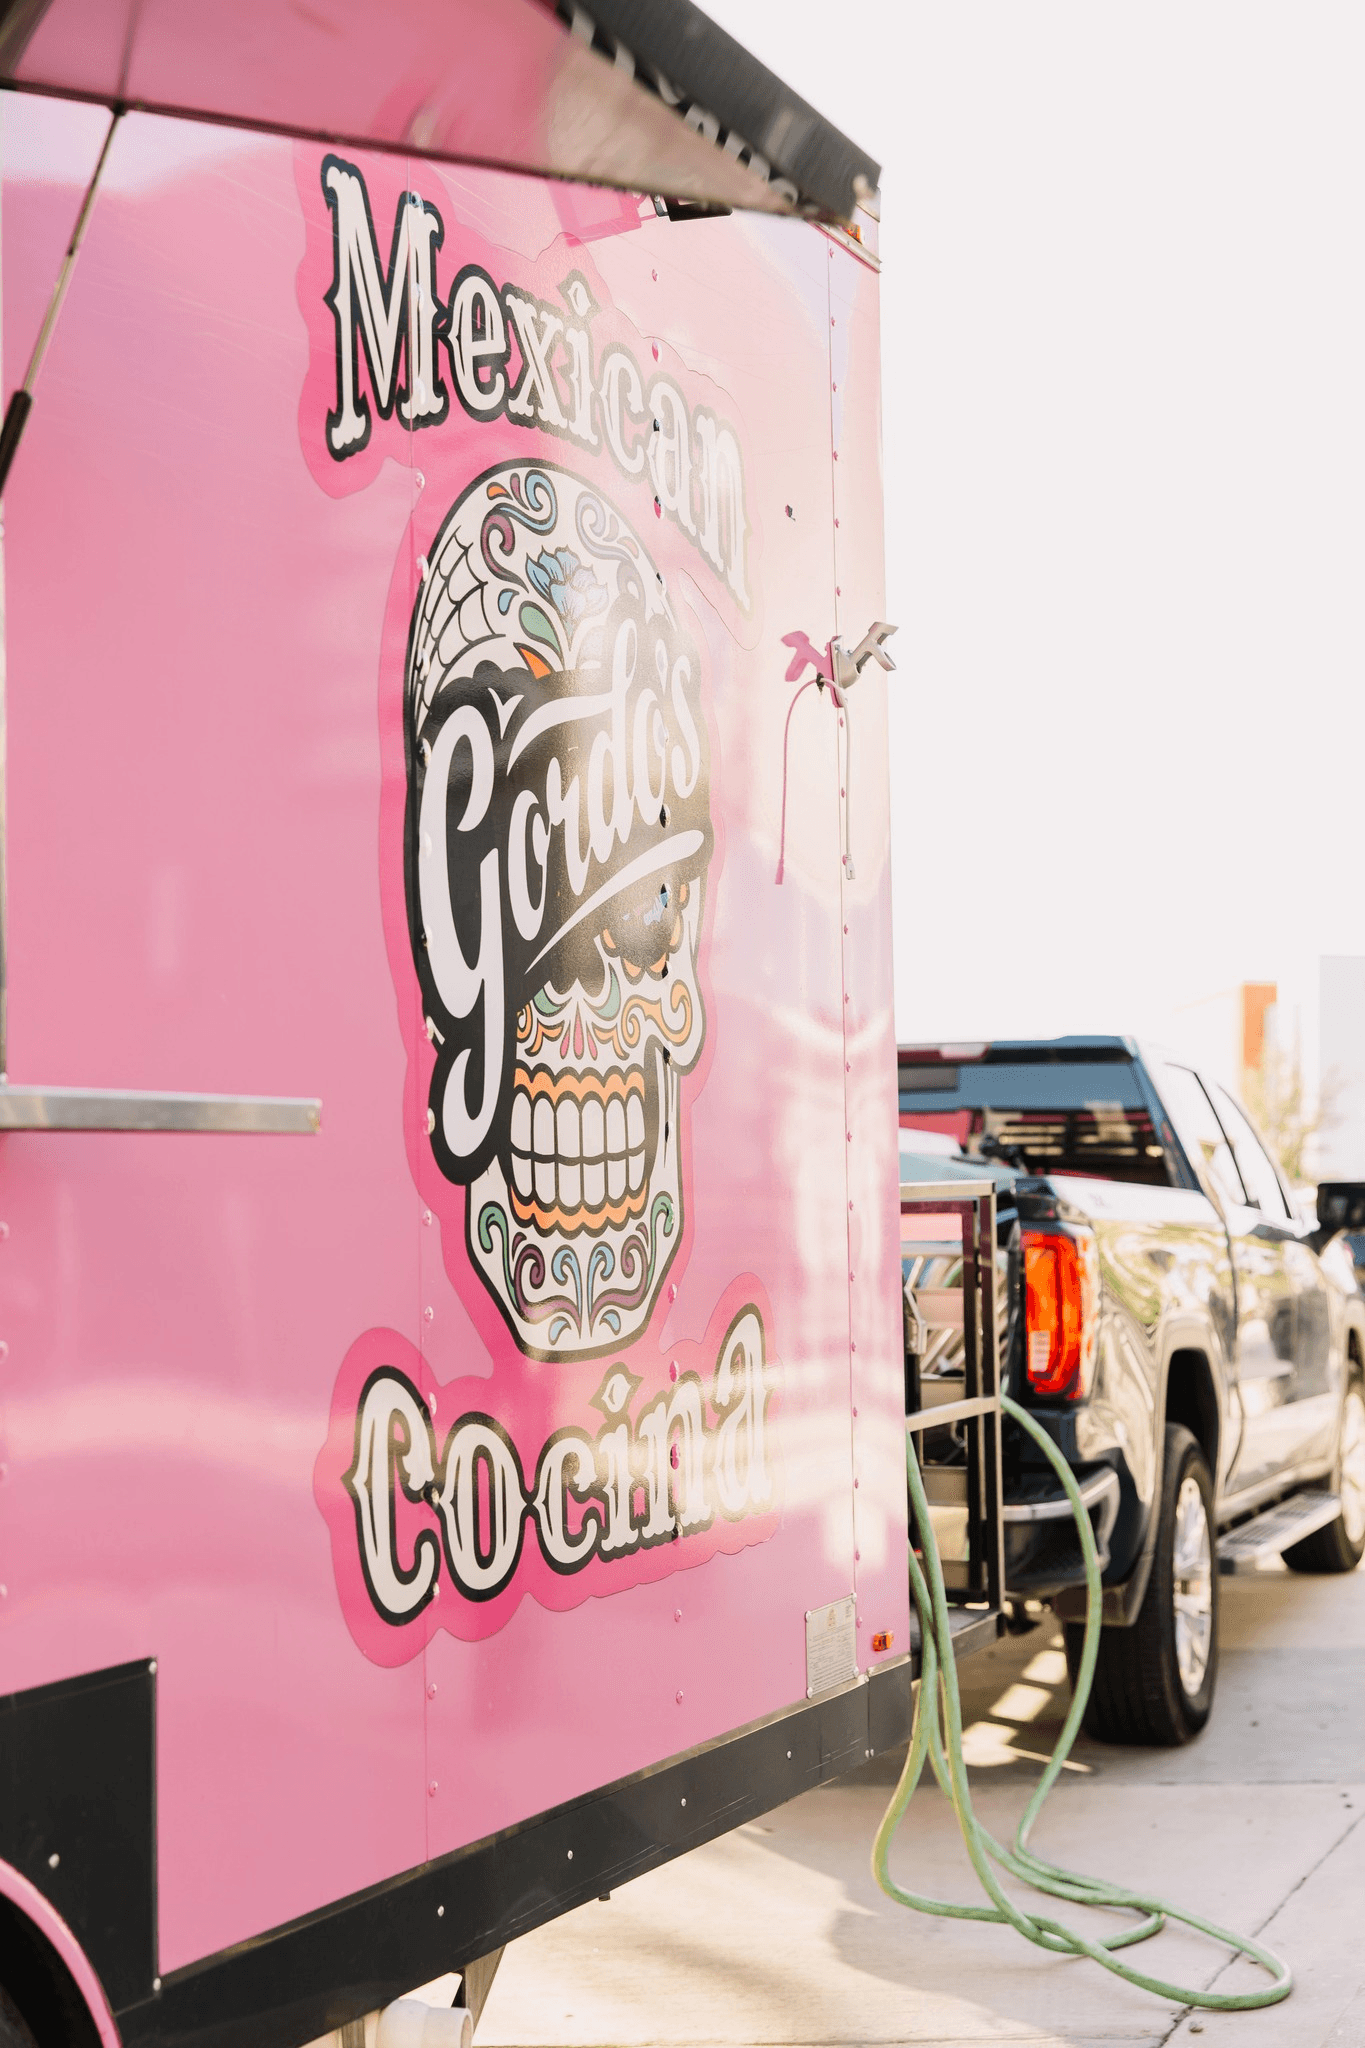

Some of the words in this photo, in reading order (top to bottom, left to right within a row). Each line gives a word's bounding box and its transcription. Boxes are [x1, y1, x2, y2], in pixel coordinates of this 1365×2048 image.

[324, 156, 754, 613] Mexican
[417, 618, 705, 1158] Gordo's
[343, 1304, 773, 1624] Cocina
